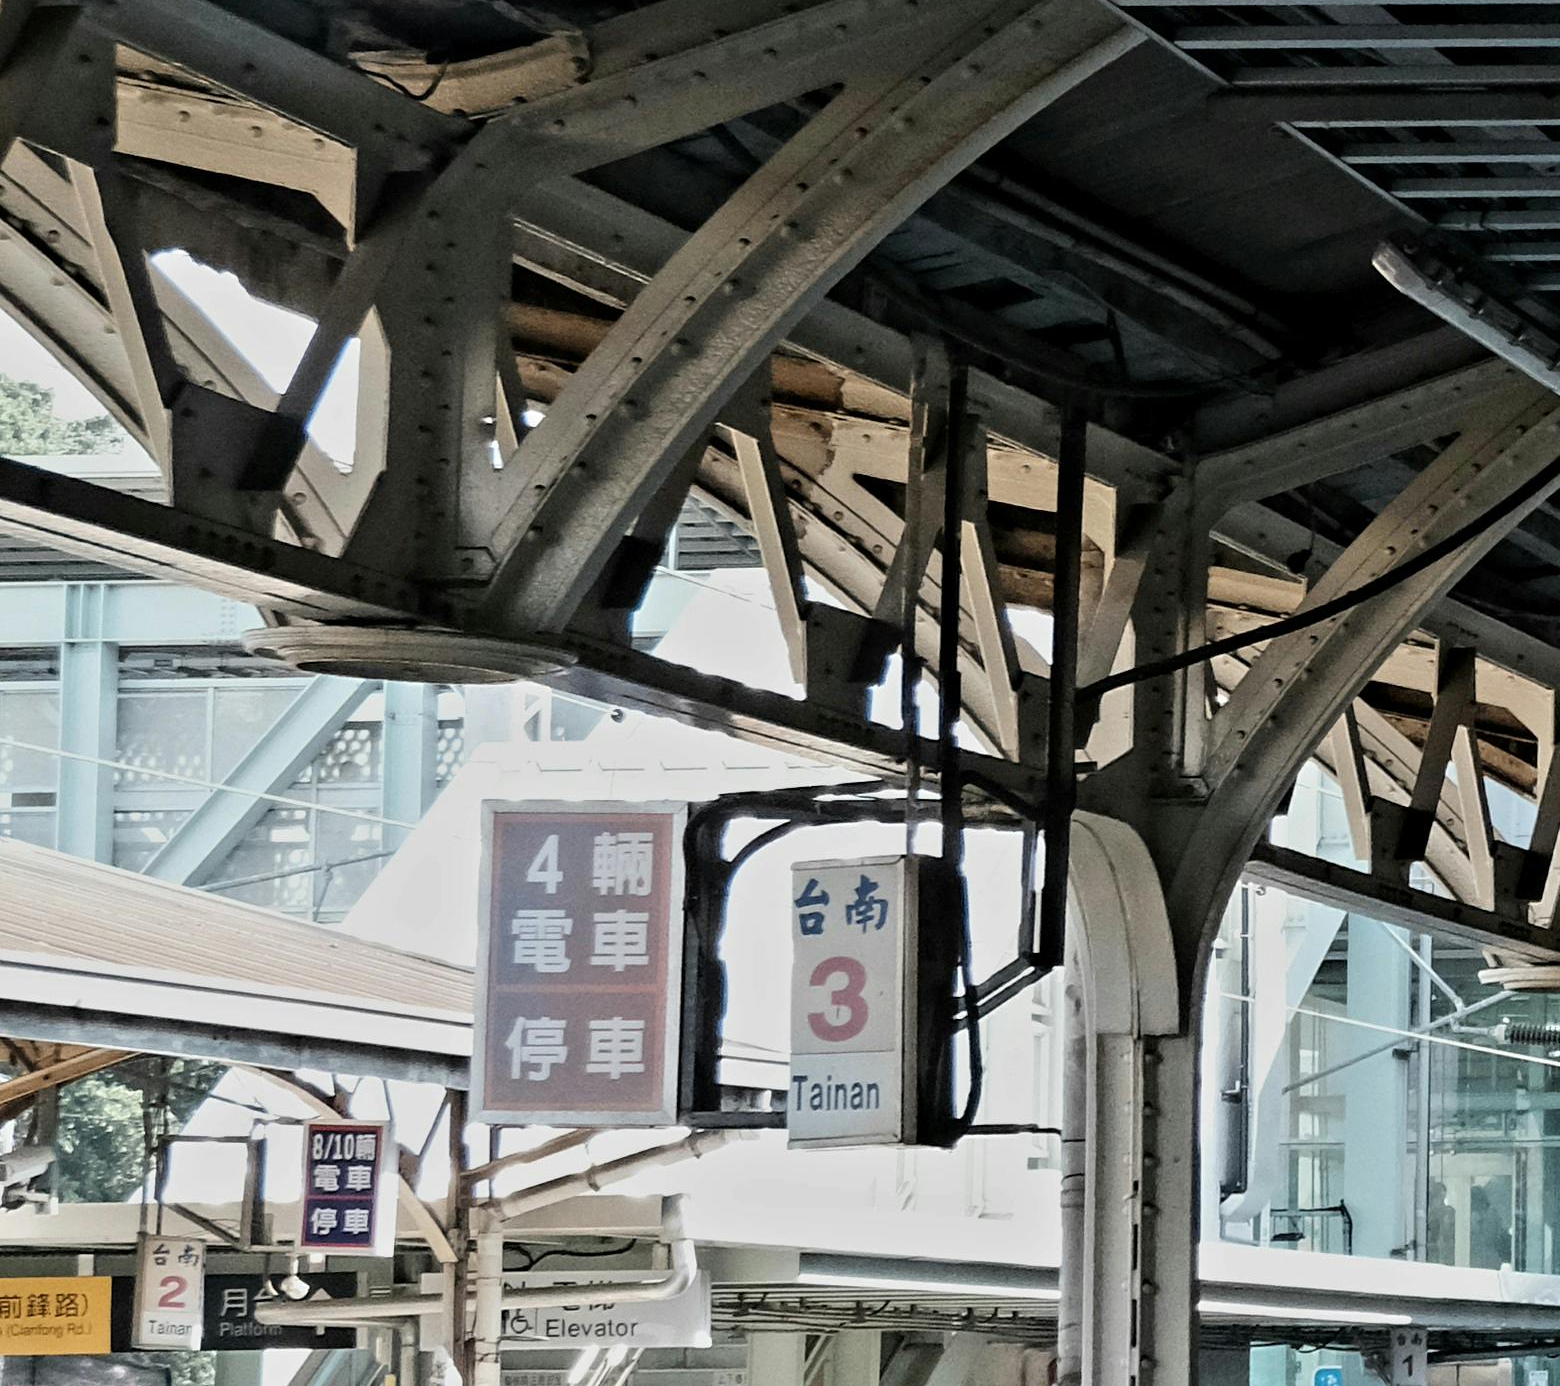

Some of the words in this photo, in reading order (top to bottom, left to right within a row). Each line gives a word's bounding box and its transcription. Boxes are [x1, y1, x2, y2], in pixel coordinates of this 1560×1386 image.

[795, 874, 889, 935] 台南
[511, 909, 651, 973] 電車
[807, 956, 869, 1042] 3
[506, 1016, 645, 1081] 停車
[792, 1075, 880, 1111] Tainan
[313, 1164, 372, 1192] 電車
[311, 1207, 370, 1235] 停車
[152, 1243, 200, 1267] 台南
[158, 1275, 188, 1309] 2
[545, 1319, 639, 1338] Elevator
[1402, 1355, 1413, 1377] 1
